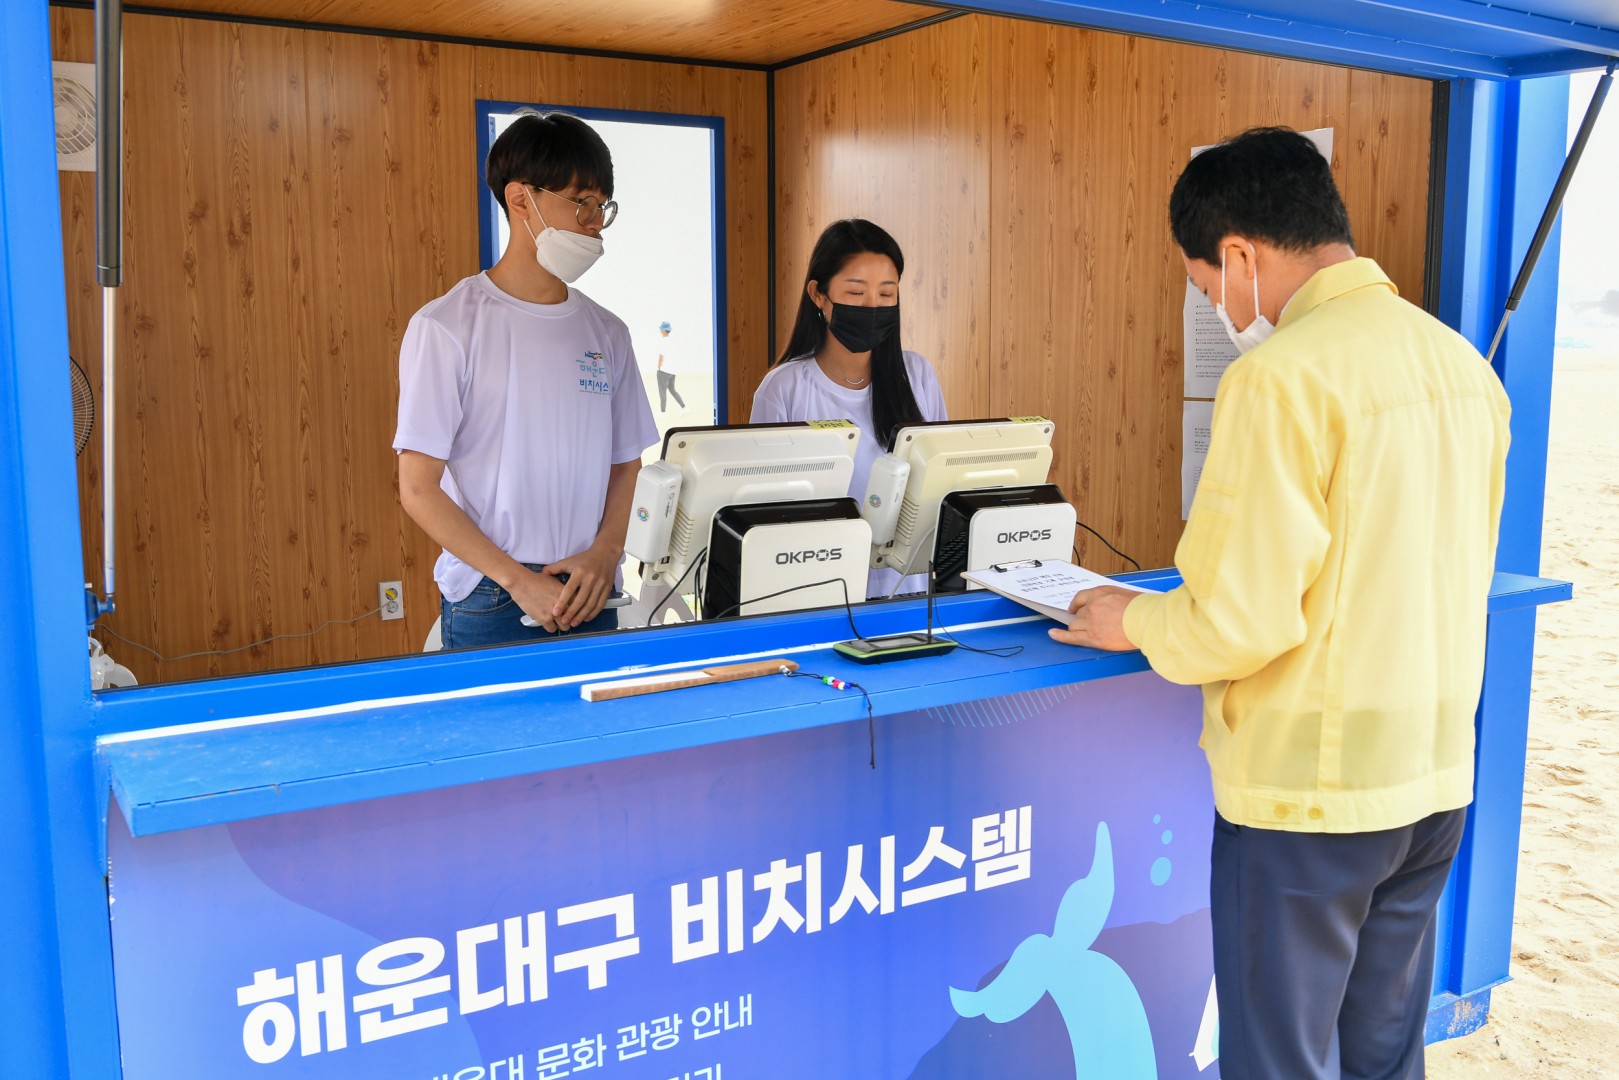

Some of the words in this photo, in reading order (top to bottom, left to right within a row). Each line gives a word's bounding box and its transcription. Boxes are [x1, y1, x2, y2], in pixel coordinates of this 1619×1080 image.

[775, 547, 843, 565] OKPOS
[997, 528, 1052, 544] OKPOS
[236, 893, 641, 1064] 해운대구
[670, 805, 1032, 964] 비치시스템
[536, 1033, 607, 1080] 문화
[616, 1013, 682, 1062] 관광
[690, 993, 753, 1041] 안내
